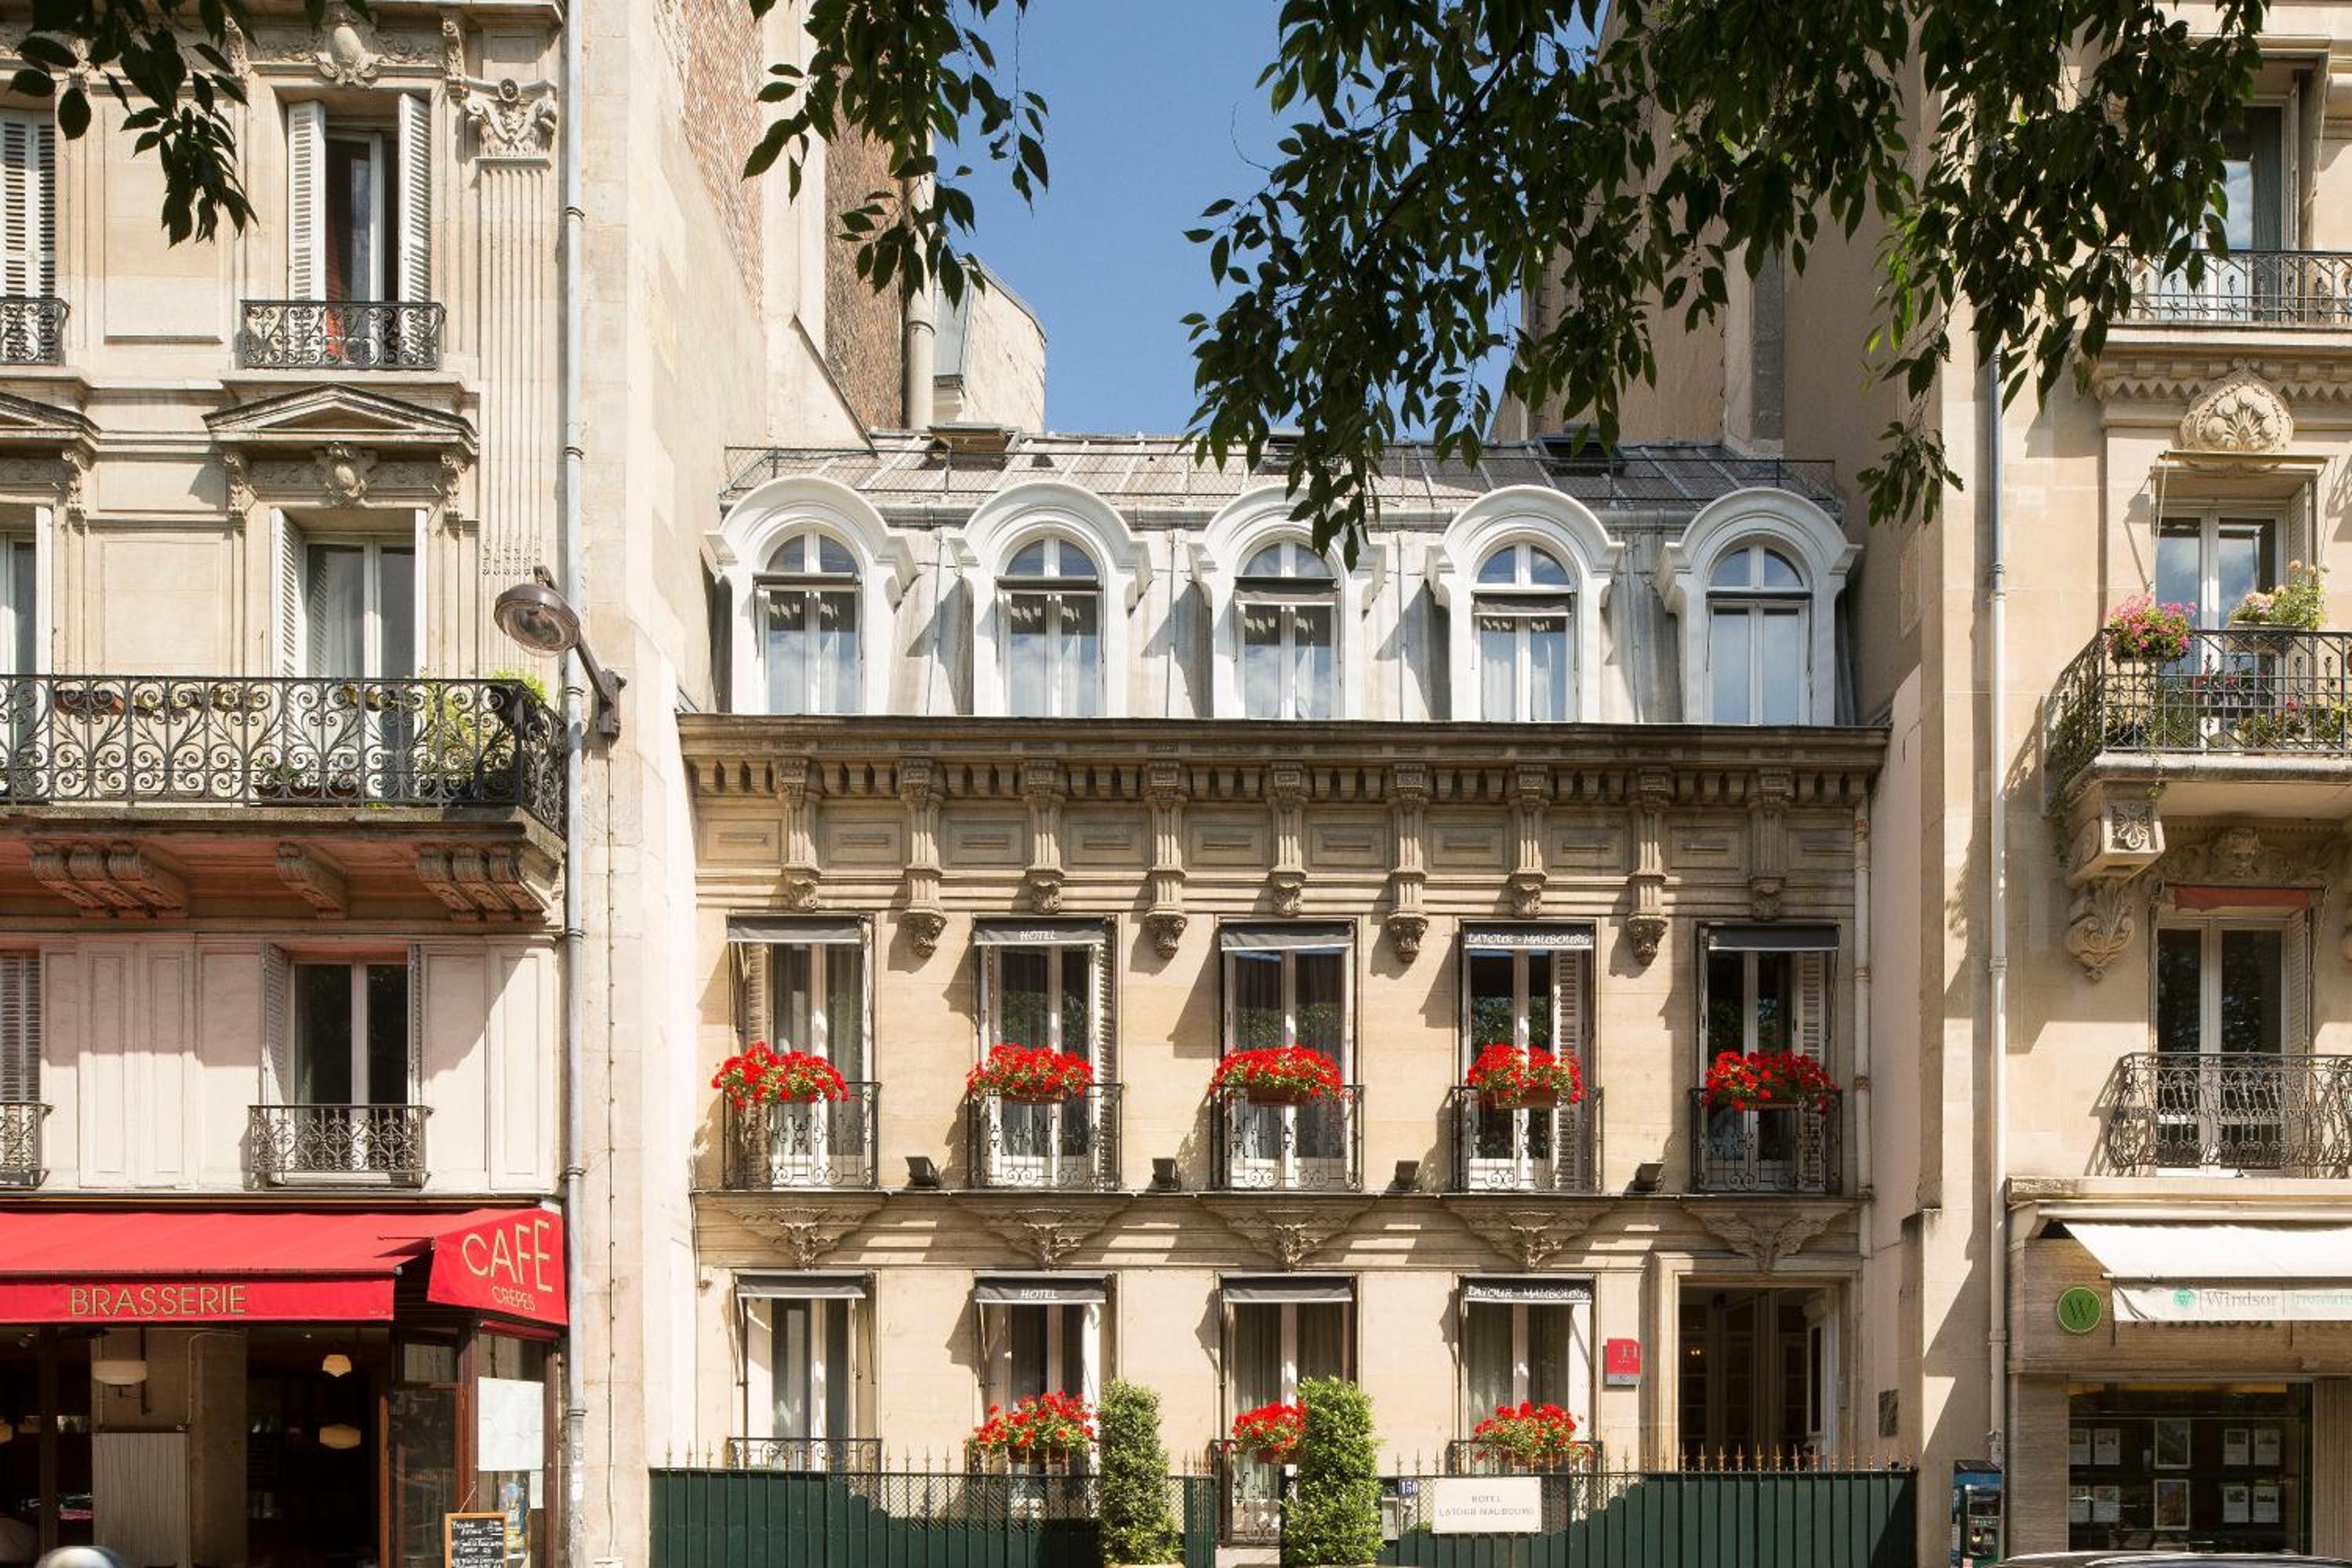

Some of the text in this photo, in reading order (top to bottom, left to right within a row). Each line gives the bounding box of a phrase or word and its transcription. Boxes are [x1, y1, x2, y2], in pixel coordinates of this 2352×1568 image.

[1020, 930, 1057, 941] HOTEL
[462, 1218, 553, 1292] CAFE
[1021, 1288, 1058, 1299] HOTEL
[1468, 1285, 1589, 1300] LATOUR MAUBOURG
[2205, 1291, 2278, 1305] Windsor
[71, 1285, 245, 1316] BRASSERIE
[2067, 1298, 2095, 1321] W
[1472, 1494, 1502, 1504] HOTEL
[1439, 1508, 1476, 1517] LATOUR
